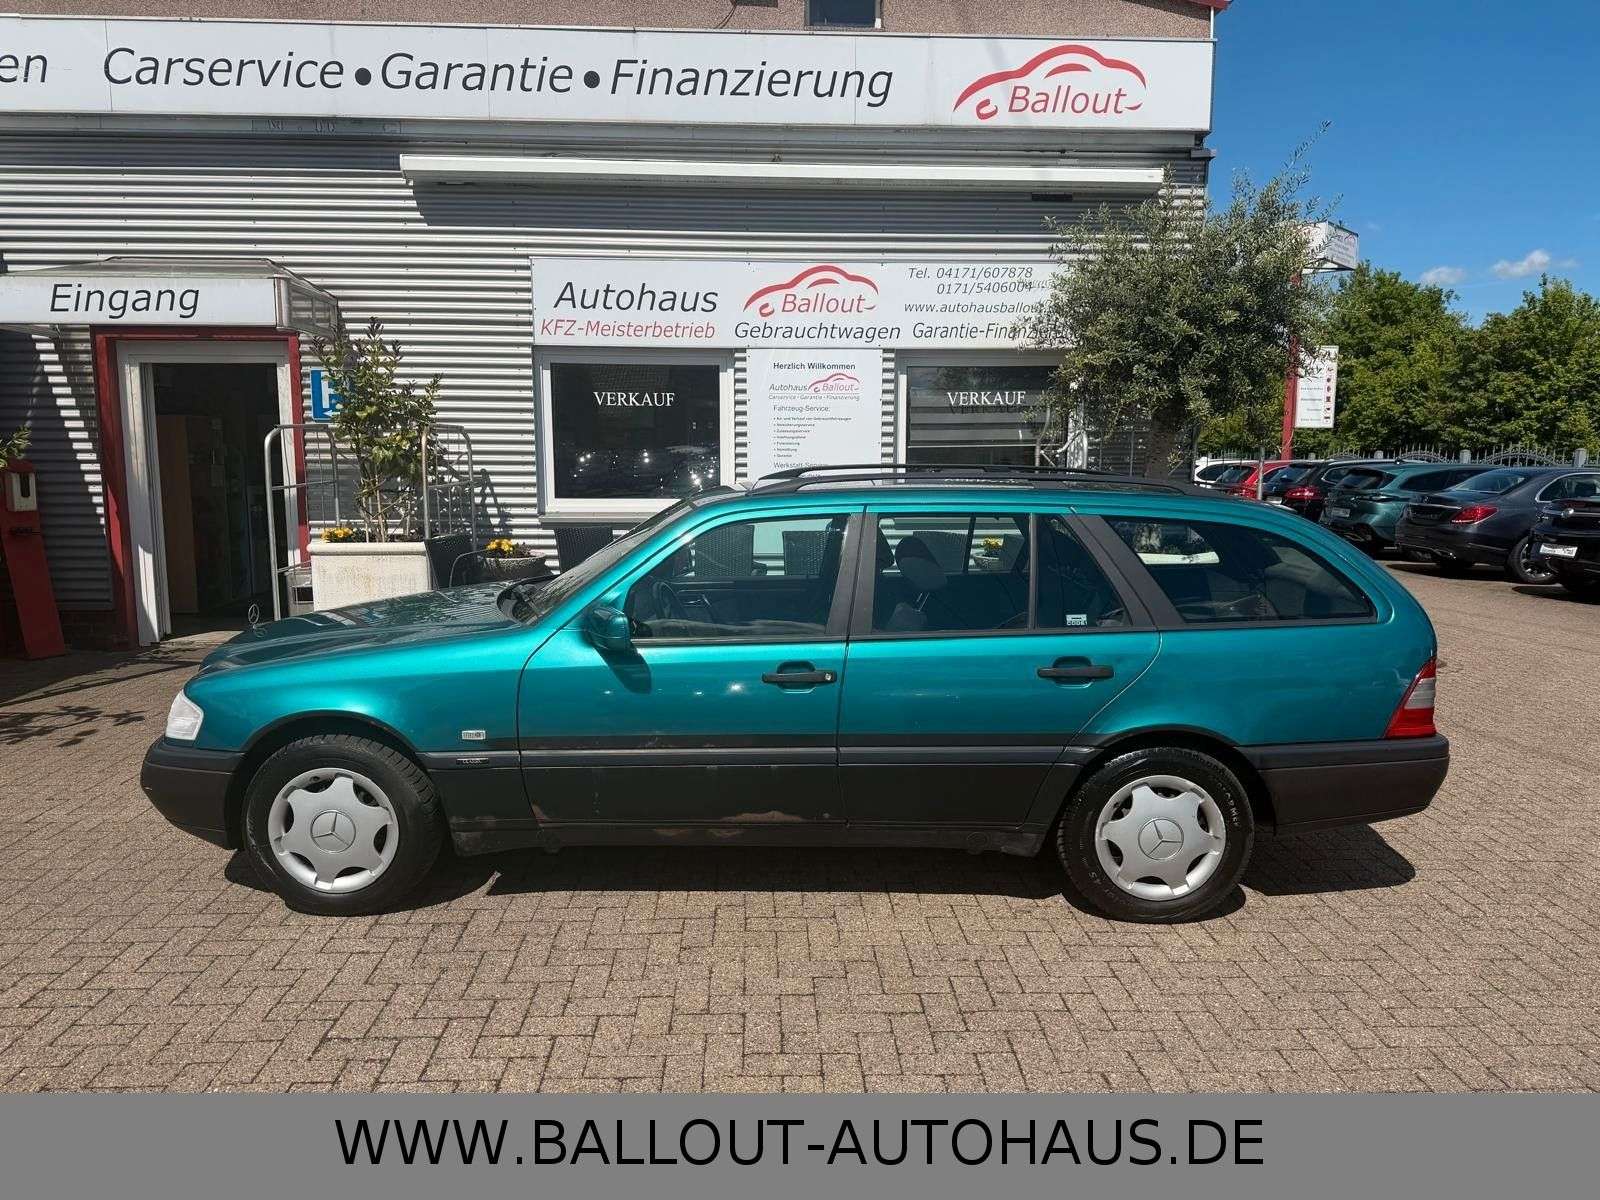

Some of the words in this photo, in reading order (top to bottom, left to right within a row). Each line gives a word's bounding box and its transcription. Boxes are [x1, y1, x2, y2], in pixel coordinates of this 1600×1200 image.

[103, 47, 344, 89] Carservice
[381, 52, 573, 94] Garantie
[610, 59, 893, 108] Finanzierung
[1008, 85, 1126, 115] Ballout
[908, 267, 931, 279] Tel.
[936, 266, 1033, 280] 04171/607878
[49, 283, 200, 319] Eingang
[553, 281, 719, 313] Autohaus
[781, 292, 865, 314] Ballout
[540, 318, 715, 339] KFZ-Meisterbetrieb
[734, 321, 901, 343] Gebrauchtwagen
[773, 362, 806, 370] Herzlich
[807, 362, 856, 370] Willkommen
[769, 383, 808, 391] Autohaus
[822, 382, 854, 391] Ballout
[593, 391, 675, 407] VERKAUF
[947, 391, 1026, 406] VERKAUF
